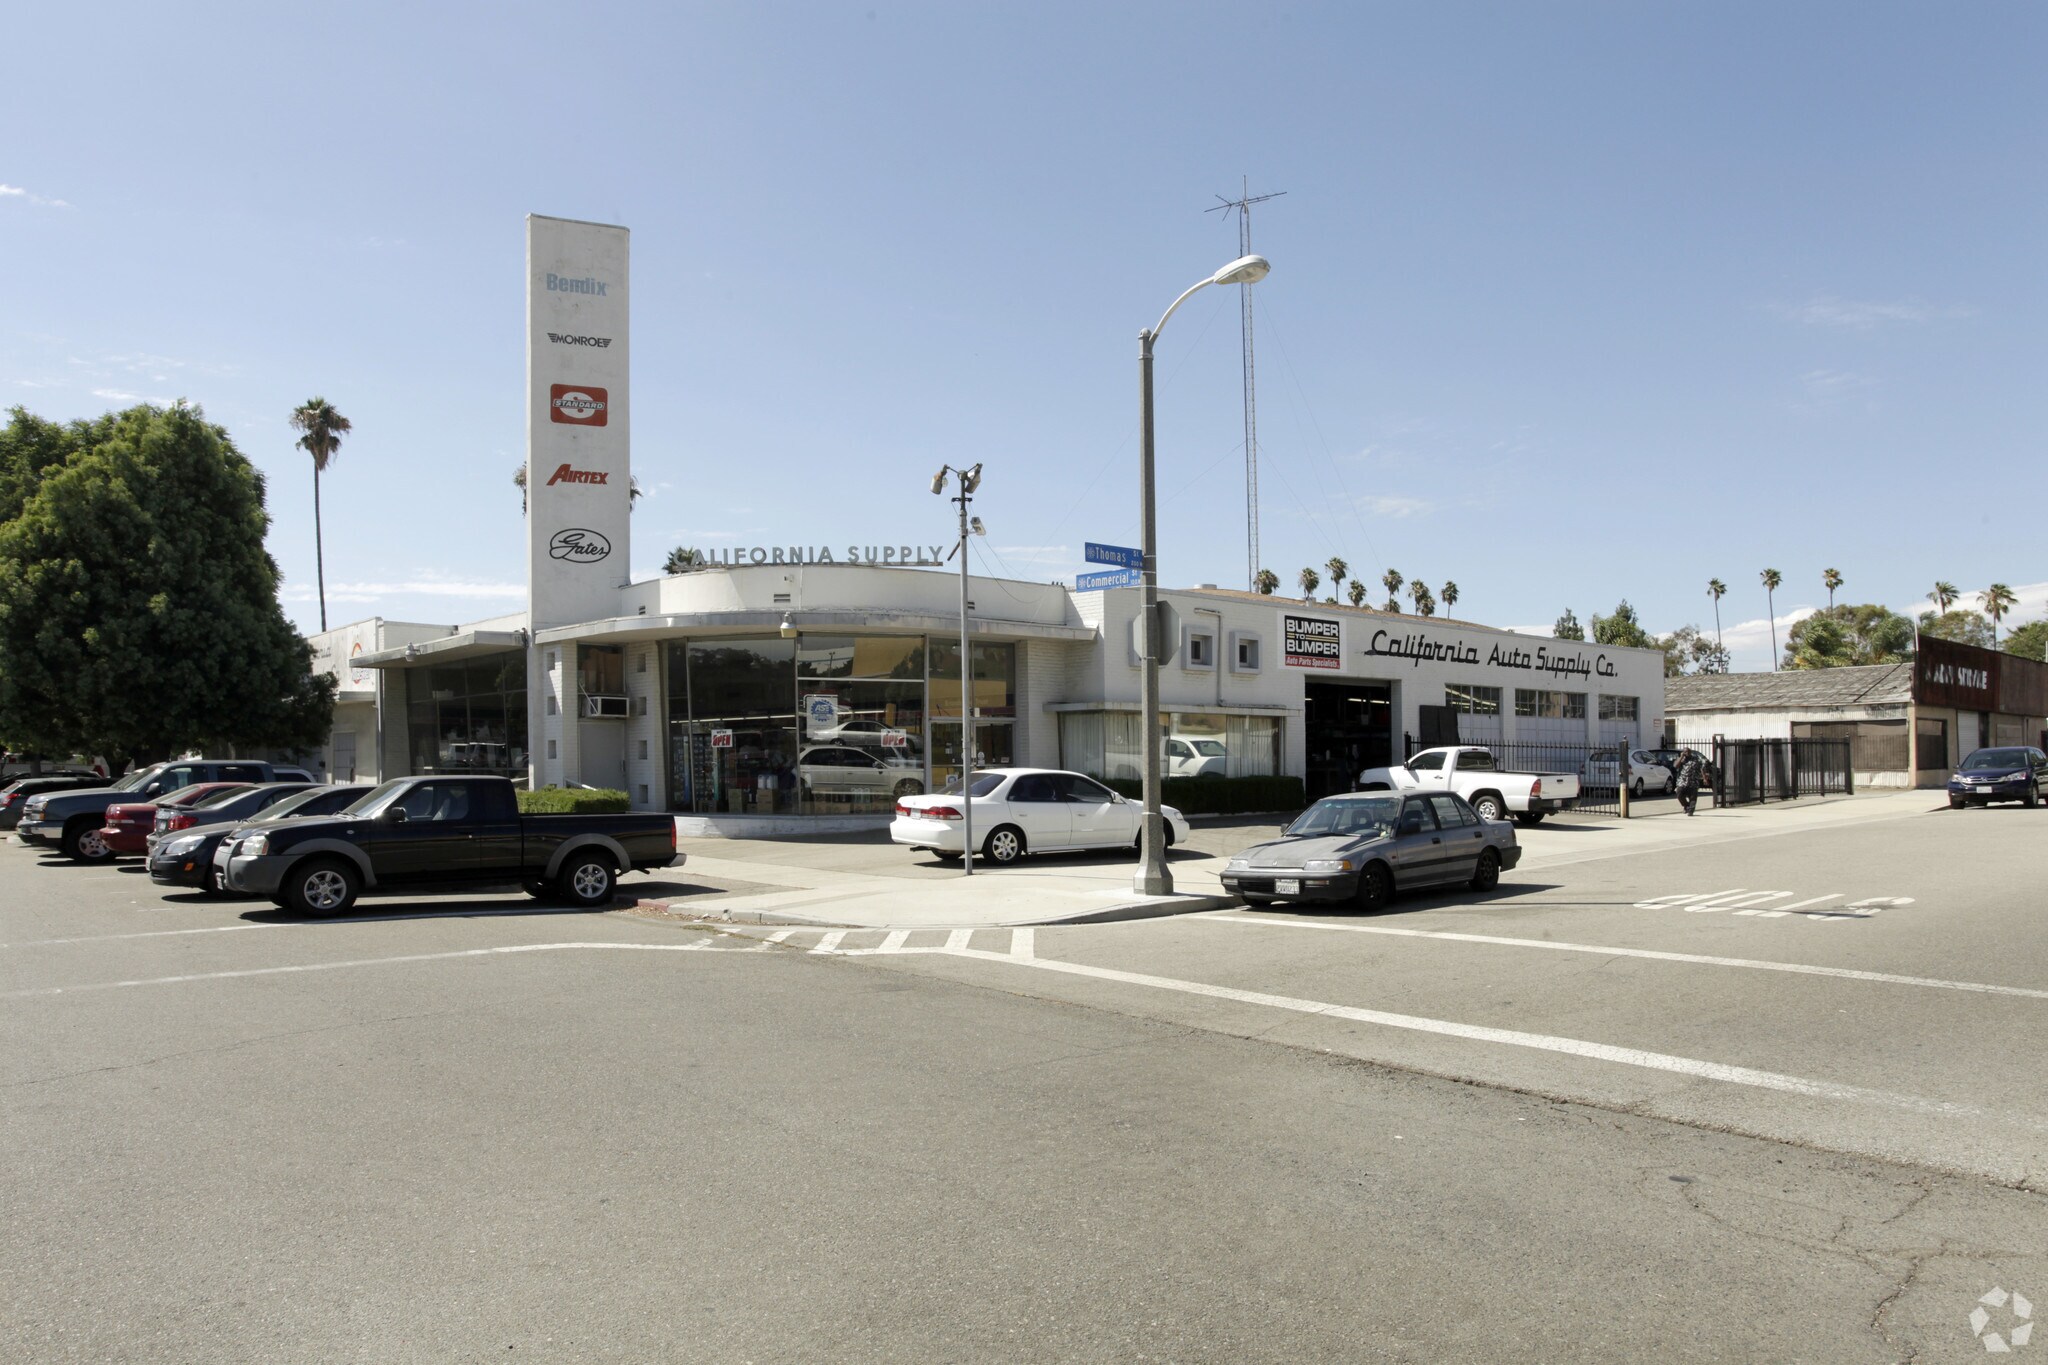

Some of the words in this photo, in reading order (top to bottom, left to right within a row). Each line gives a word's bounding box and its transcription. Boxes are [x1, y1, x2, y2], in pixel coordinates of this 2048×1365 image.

[546, 273, 607, 296] Bendix
[556, 334, 604, 348] MONROE
[554, 400, 604, 409] STANDARD
[546, 463, 609, 486] AIRTEX
[549, 533, 608, 559] Gates
[673, 546, 834, 567] CALIFORNIA
[847, 545, 943, 563] SUPPLY
[1095, 547, 1127, 562] Thomas
[1086, 572, 1129, 588] Commercial
[1286, 619, 1338, 636] BUMPER
[1286, 639, 1339, 655] BUMPER
[1363, 629, 1480, 667] California
[1487, 642, 1532, 669] Auto
[1535, 647, 1591, 681] Supply
[1286, 656, 1298, 664] Auto
[1299, 657, 1311, 666] Parts
[712, 734, 731, 746] OPEN
